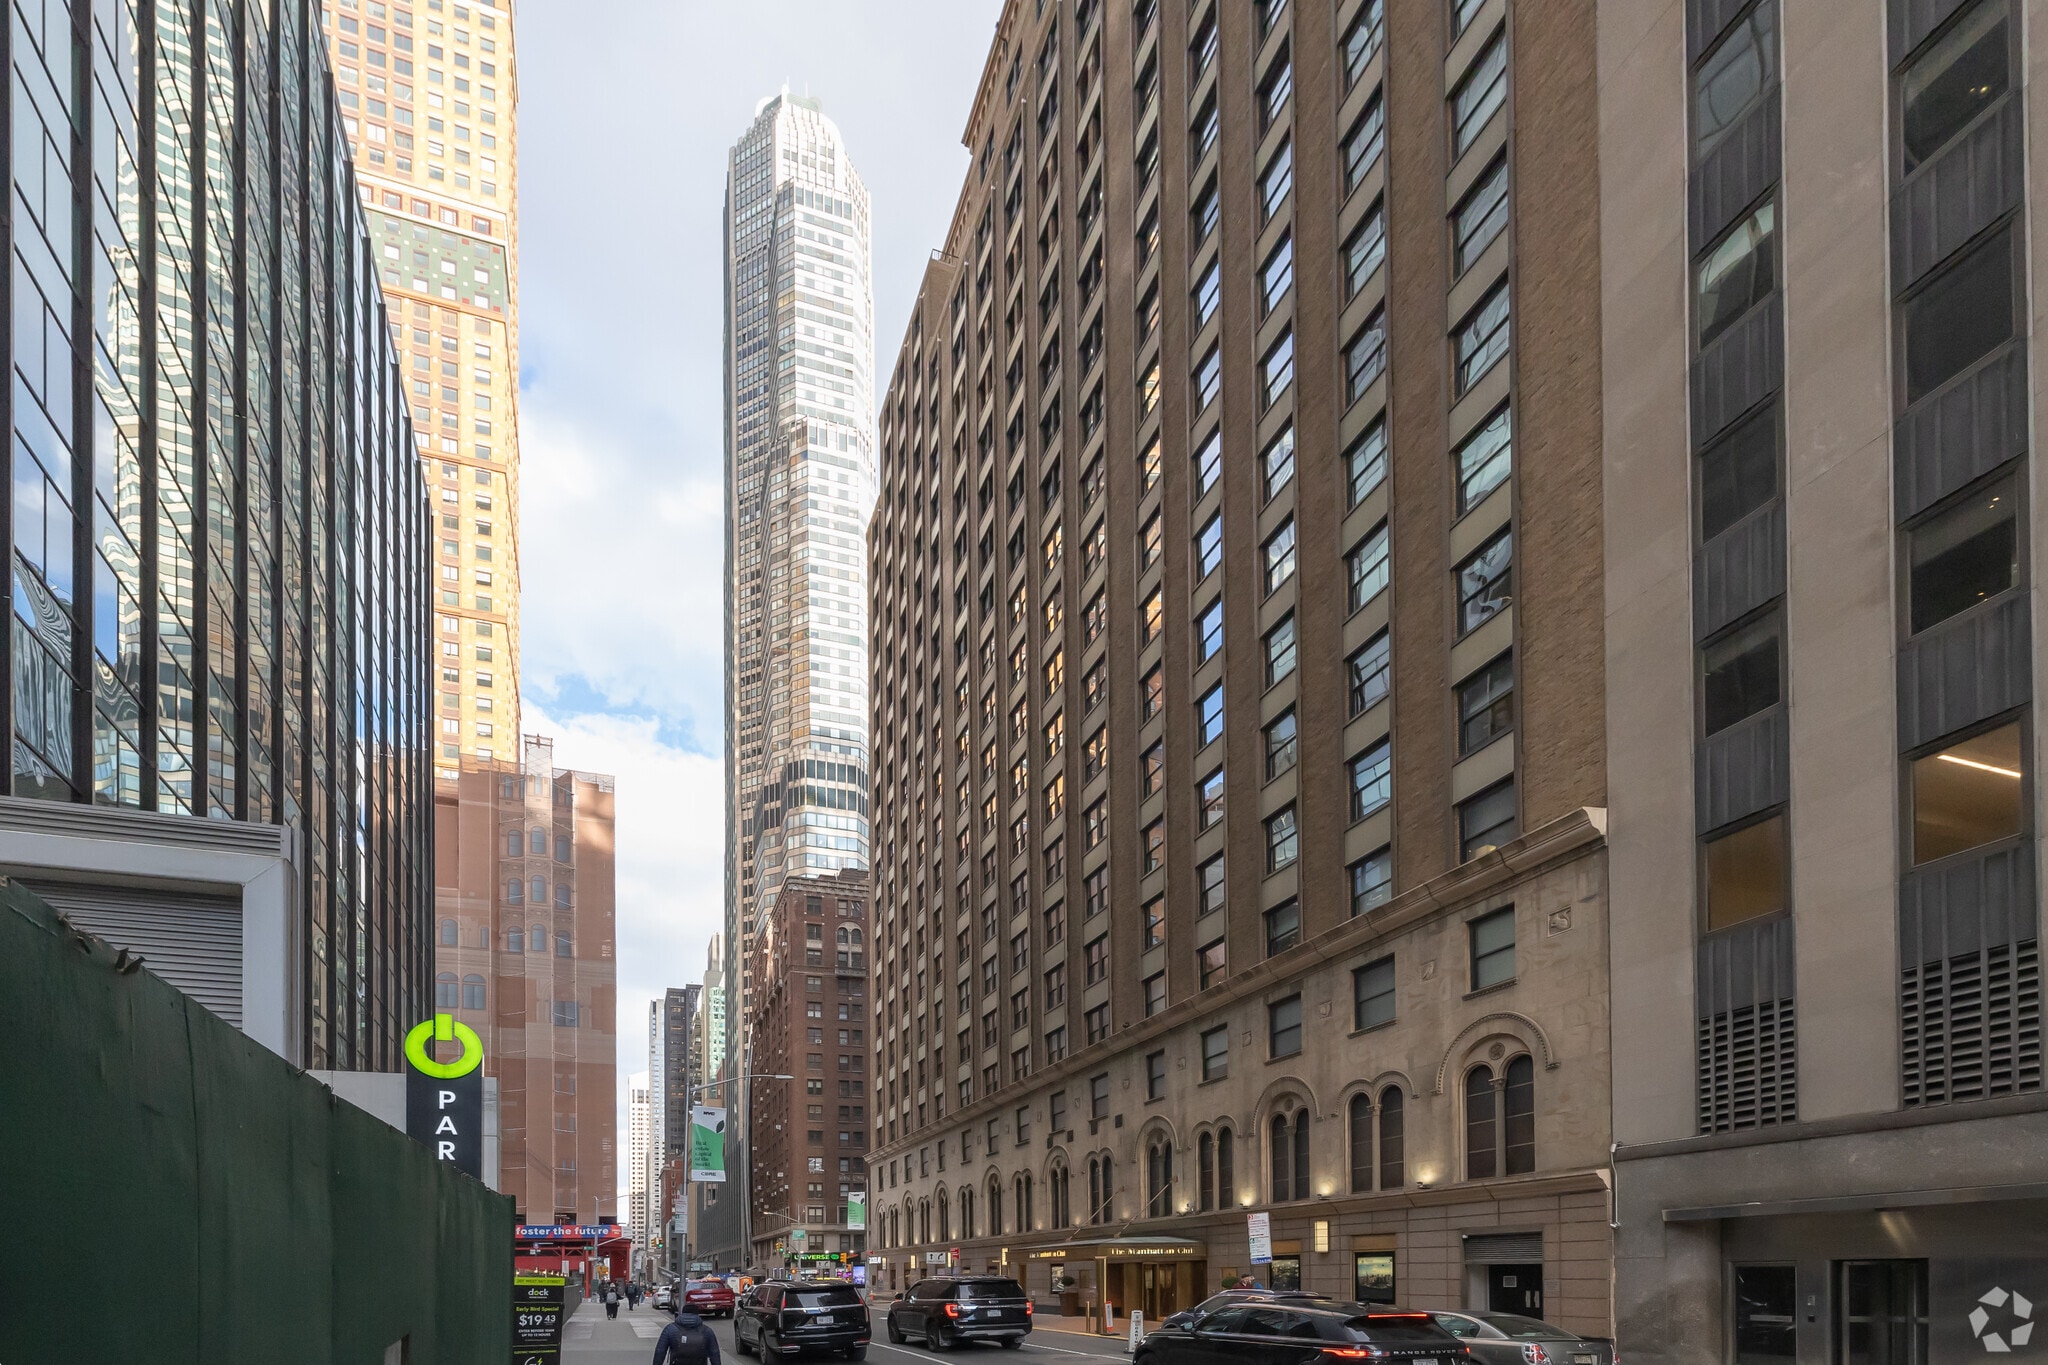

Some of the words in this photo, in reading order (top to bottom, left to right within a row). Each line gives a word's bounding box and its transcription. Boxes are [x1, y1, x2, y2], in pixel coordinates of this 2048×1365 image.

[516, 1227, 551, 1235] foster
[553, 1227, 572, 1235] the
[574, 1227, 609, 1235] future
[1111, 1247, 1125, 1255] The
[1127, 1247, 1175, 1255] Manhattan
[528, 1288, 549, 1296] dock
[519, 1313, 543, 1327] $19
[544, 1314, 556, 1322] 43
